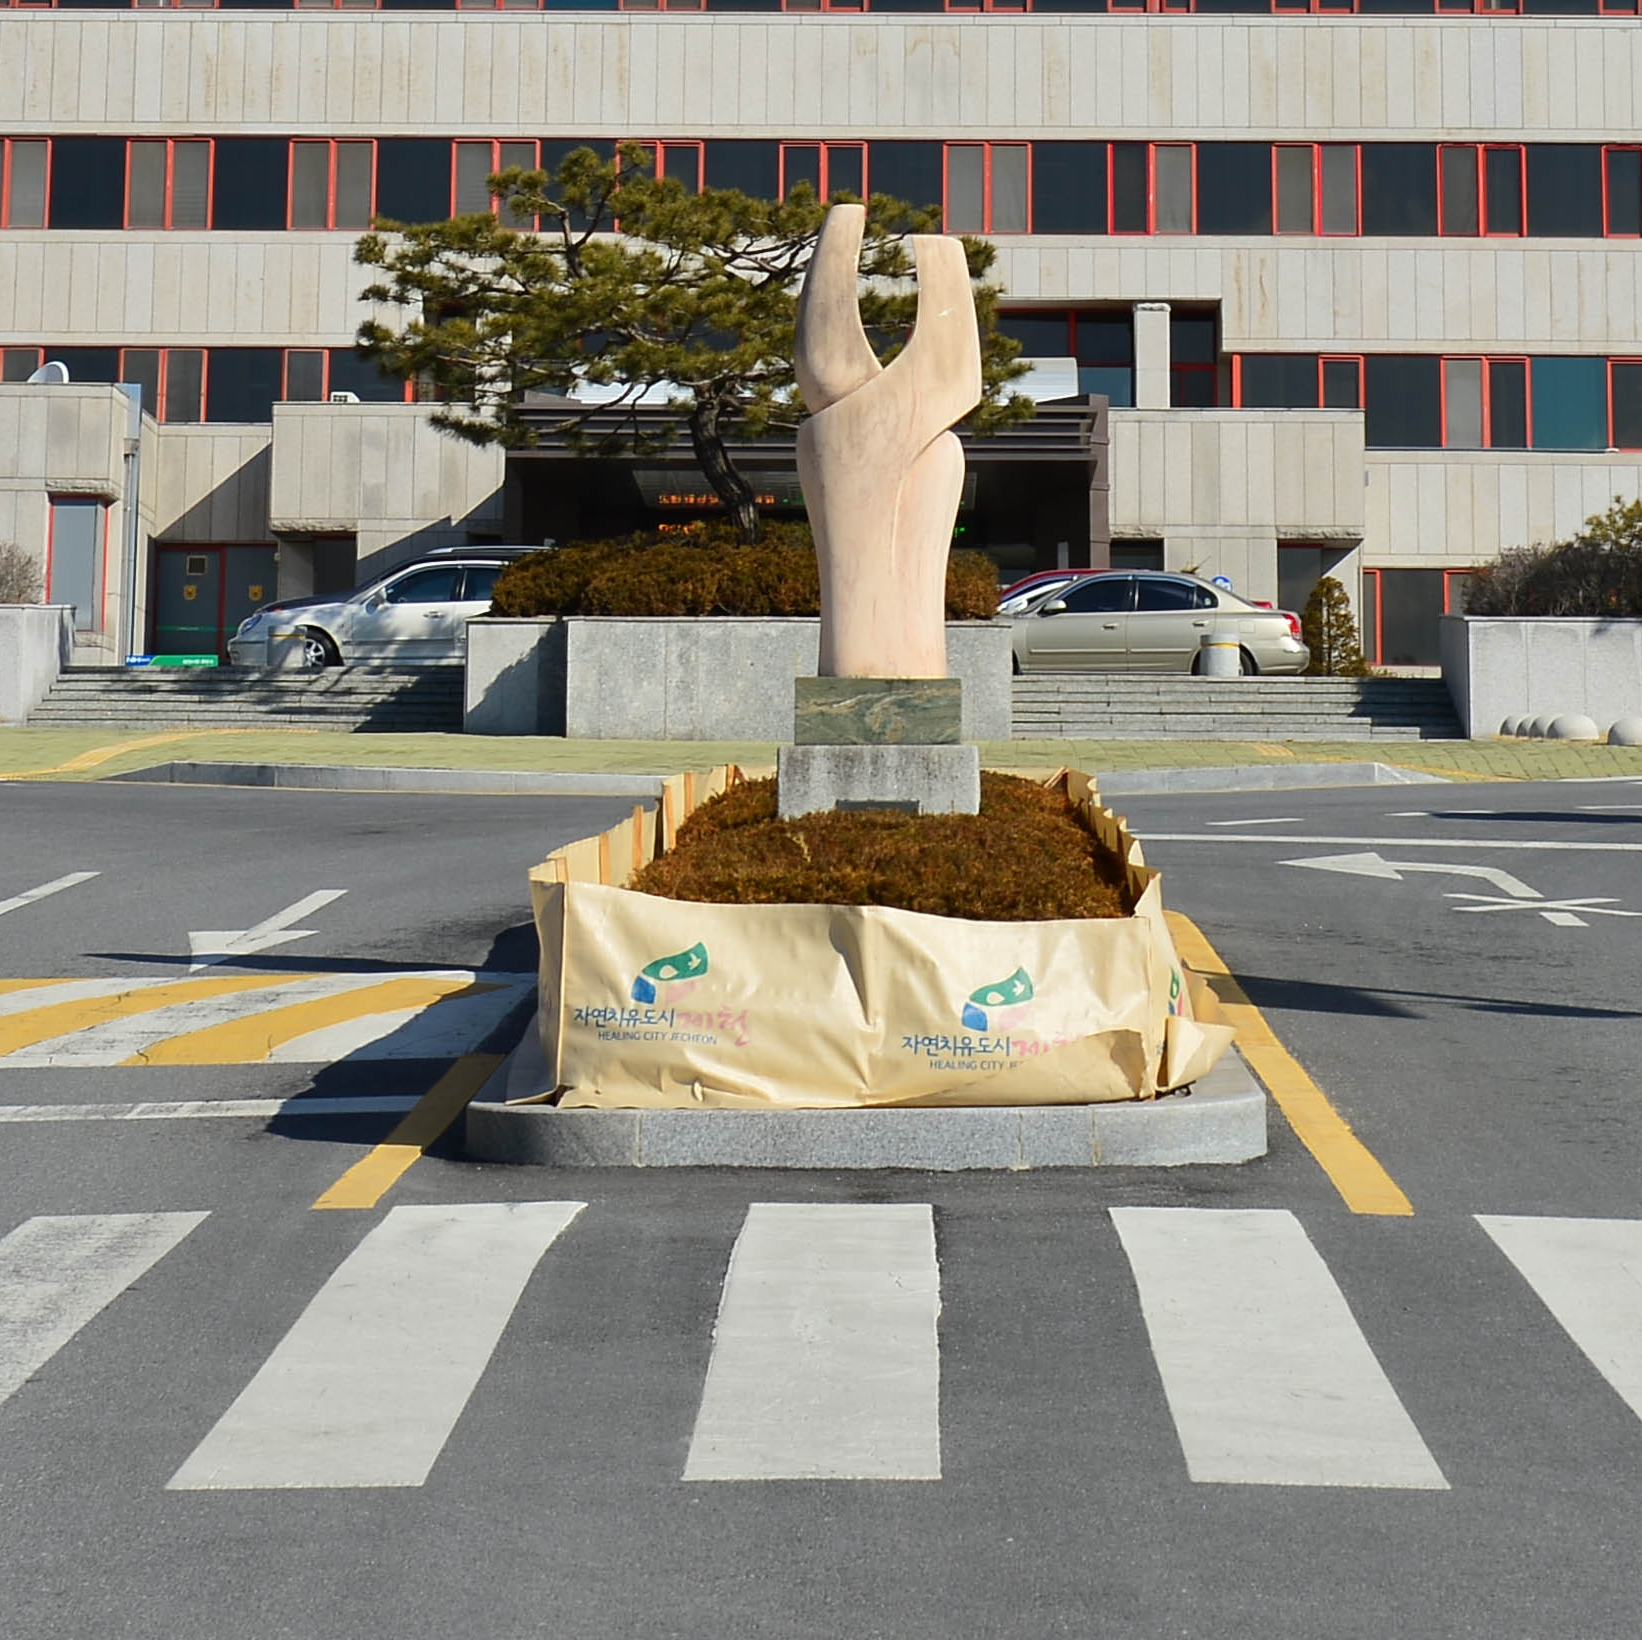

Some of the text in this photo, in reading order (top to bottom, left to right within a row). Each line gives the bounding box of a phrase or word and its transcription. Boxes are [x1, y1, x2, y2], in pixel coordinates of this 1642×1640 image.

[597, 1030, 718, 1046] HEALING CITY JECHEON
[929, 1059, 978, 1071] HEALING
[980, 1059, 1005, 1071] CITY
